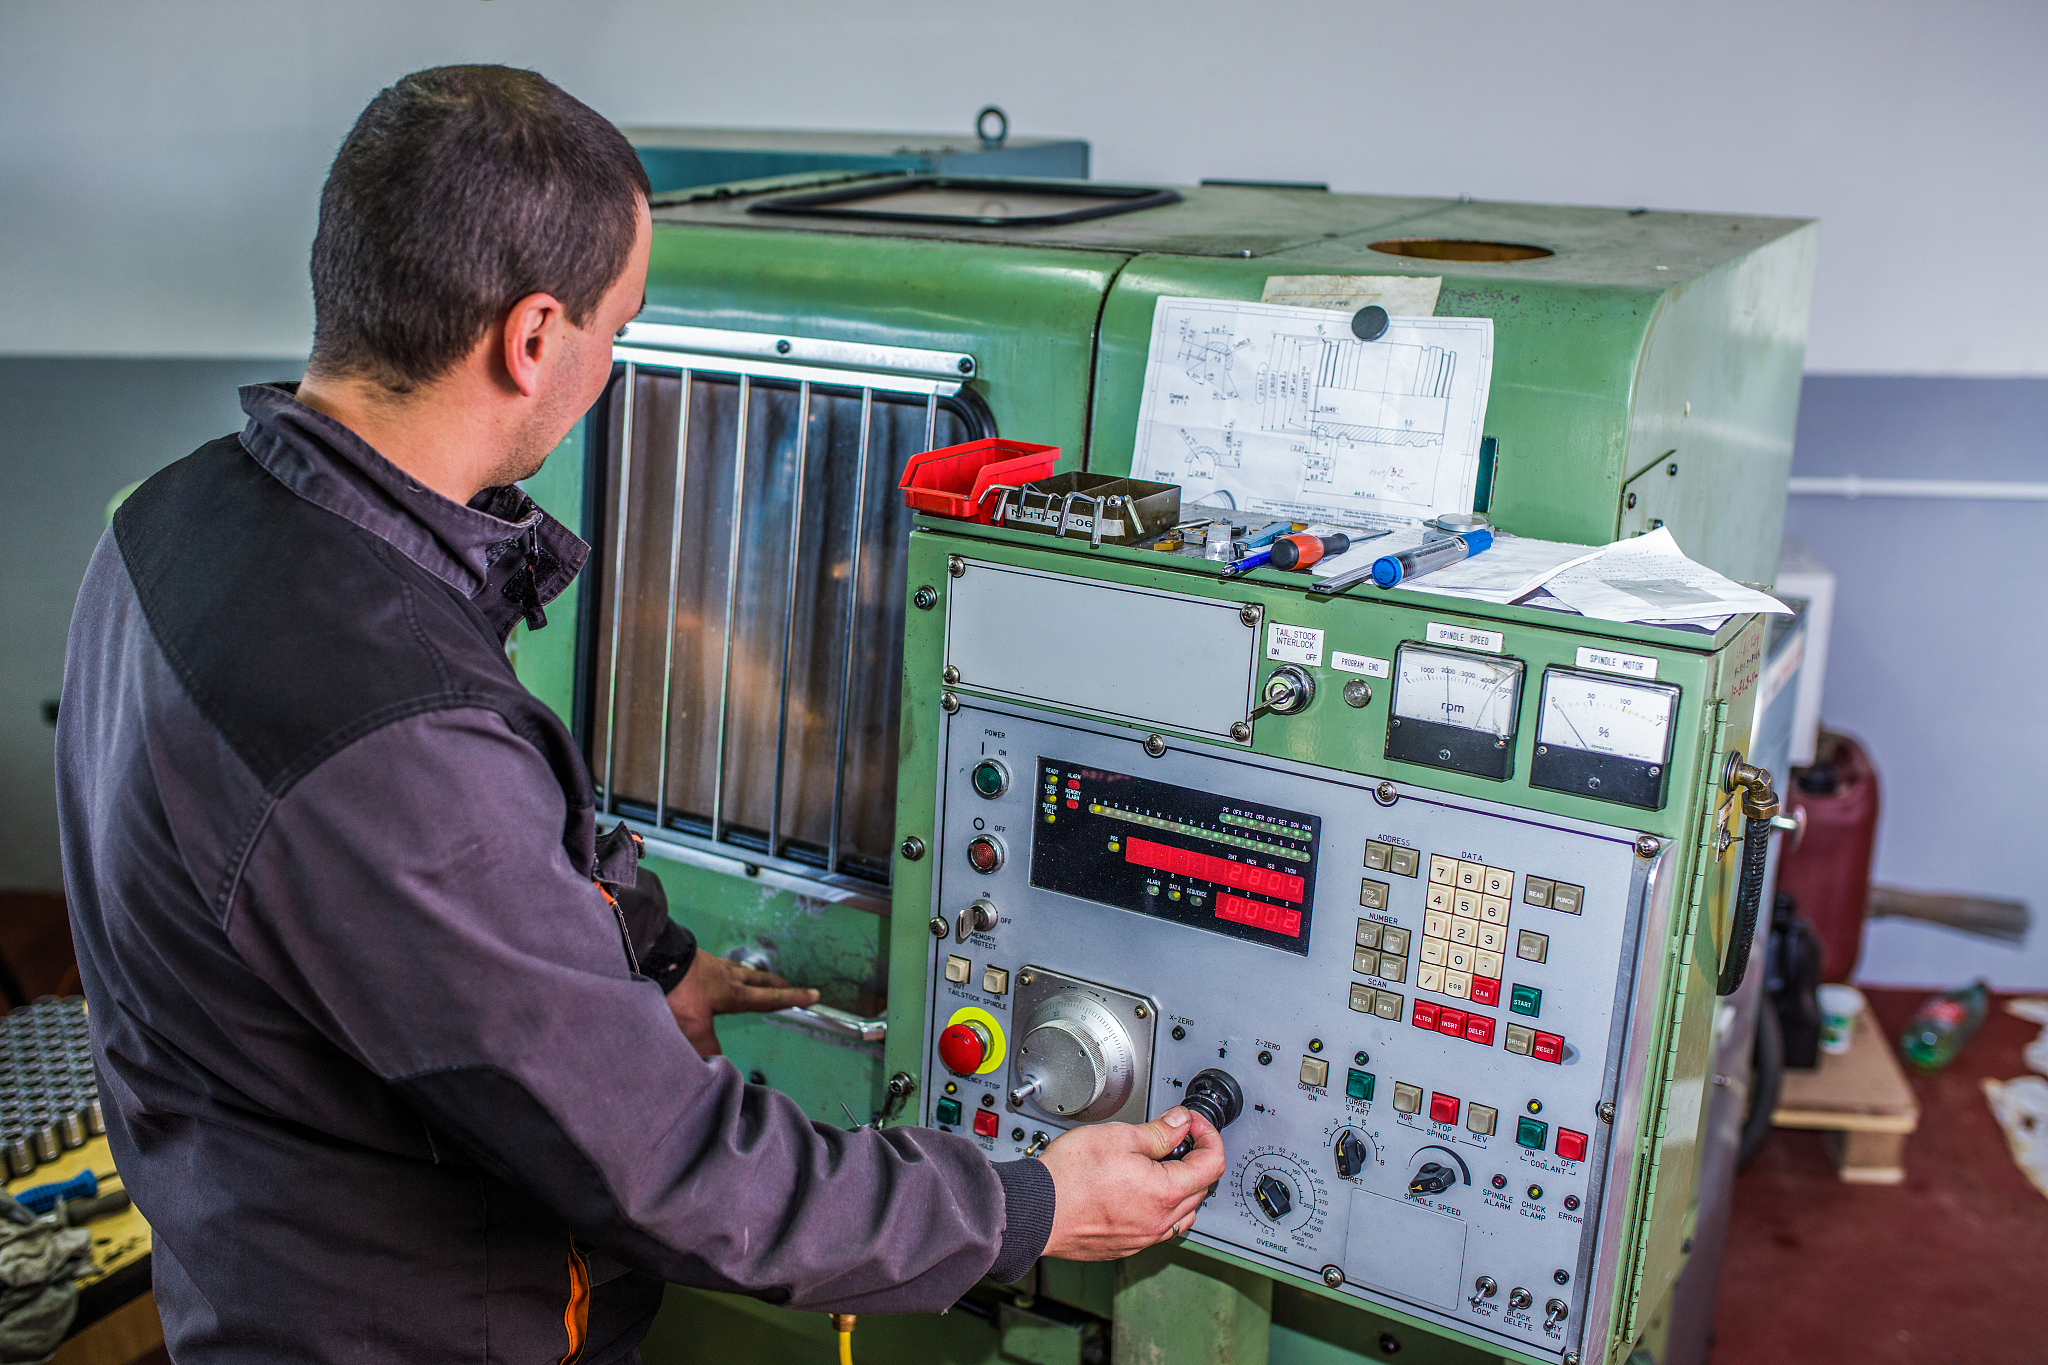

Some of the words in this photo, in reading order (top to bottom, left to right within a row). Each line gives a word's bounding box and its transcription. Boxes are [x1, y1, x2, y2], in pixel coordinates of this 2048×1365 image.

[1012, 508, 1092, 528] NHT-0-06
[1276, 628, 1290, 638] TAIL
[1294, 630, 1316, 640] STOCK
[1440, 630, 1464, 642] SPINDLE
[1470, 635, 1489, 645] SPEED
[1276, 637, 1314, 649] INTERLOCK
[1341, 658, 1364, 668] PROGRAM
[1369, 663, 1378, 671] END
[1590, 655, 1616, 666] SPINDLE
[1622, 660, 1644, 671] MOTOR
[1420, 666, 1434, 674] 1000
[1441, 702, 1465, 713] rpm
[1656, 714, 1668, 722] 150
[984, 729, 1005, 739] POWER
[1599, 726, 1609, 738] %
[1045, 767, 1059, 775] READY
[1067, 772, 1081, 780] ALARM
[1378, 833, 1410, 846] ADDRESS
[1462, 851, 1483, 862] DATA
[1147, 878, 1161, 886] ALARM
[1437, 868, 1445, 878] 7
[1464, 874, 1472, 883] 8
[1492, 880, 1499, 890] 9
[1169, 883, 1181, 891] DATA
[1528, 891, 1544, 899] READ
[1556, 896, 1574, 905] PUNCH
[1433, 895, 1442, 905] 4
[1460, 902, 1469, 911] 5
[1488, 907, 1496, 917] 6
[1369, 912, 1398, 925] NUMBER
[971, 931, 996, 942] MEMORY
[1457, 928, 1465, 938] 2
[1485, 935, 1493, 944] 3
[970, 938, 997, 950] PROTECT
[1383, 962, 1397, 970] INCR
[1454, 956, 1463, 965] 0
[1368, 978, 1387, 988] SCAN
[1449, 982, 1462, 991] EOB
[1475, 990, 1488, 998] CAN
[948, 988, 980, 1002] TAILSTOCK
[983, 998, 1007, 1010] SPINDLE
[1513, 999, 1532, 1008] START
[1169, 1014, 1194, 1026] X-ZERO
[1415, 1014, 1431, 1023] ALTER
[1442, 1020, 1458, 1030] INSRT
[1468, 1027, 1486, 1037] DELET
[1255, 1039, 1281, 1051] Z-ZERO
[1536, 1045, 1554, 1054] RESET
[949, 1070, 982, 1084] EMENCY
[984, 1081, 1001, 1090] STOP
[1298, 1083, 1328, 1097] CONTROL
[1308, 1094, 1317, 1102] ON
[1345, 1097, 1372, 1110] TURRET
[1345, 1104, 1370, 1116] START
[1399, 1112, 1412, 1121] NOR
[1432, 1122, 1452, 1132] STOP
[1472, 1134, 1487, 1143] REV
[1426, 1129, 1457, 1143] SPINDLE
[1525, 1149, 1535, 1157] ON
[1560, 1160, 1576, 1169] OFF
[1530, 1160, 1566, 1175] COOLANT
[1338, 1175, 1363, 1185] URRET
[1483, 1189, 1513, 1203] SPINDLE
[1404, 1193, 1434, 1207] SPINDLE
[1438, 1203, 1461, 1216] SPEED
[1484, 1198, 1511, 1210] ALARM
[1521, 1201, 1546, 1213] CHUCK
[1317, 1209, 1327, 1217] 520
[1520, 1208, 1546, 1221] CLAMP
[1558, 1211, 1583, 1224] ERROR
[1309, 1224, 1321, 1232] 1000
[1292, 1234, 1304, 1243] 2000
[1301, 1231, 1313, 1239] 1400
[1256, 1238, 1288, 1253] OVERRIDE
[1467, 1296, 1499, 1312] MCHINE
[1472, 1306, 1491, 1317] LOCK
[1507, 1310, 1530, 1322] BLOCK
[1504, 1316, 1533, 1331] DELETE
[1546, 1331, 1560, 1340] RUN
